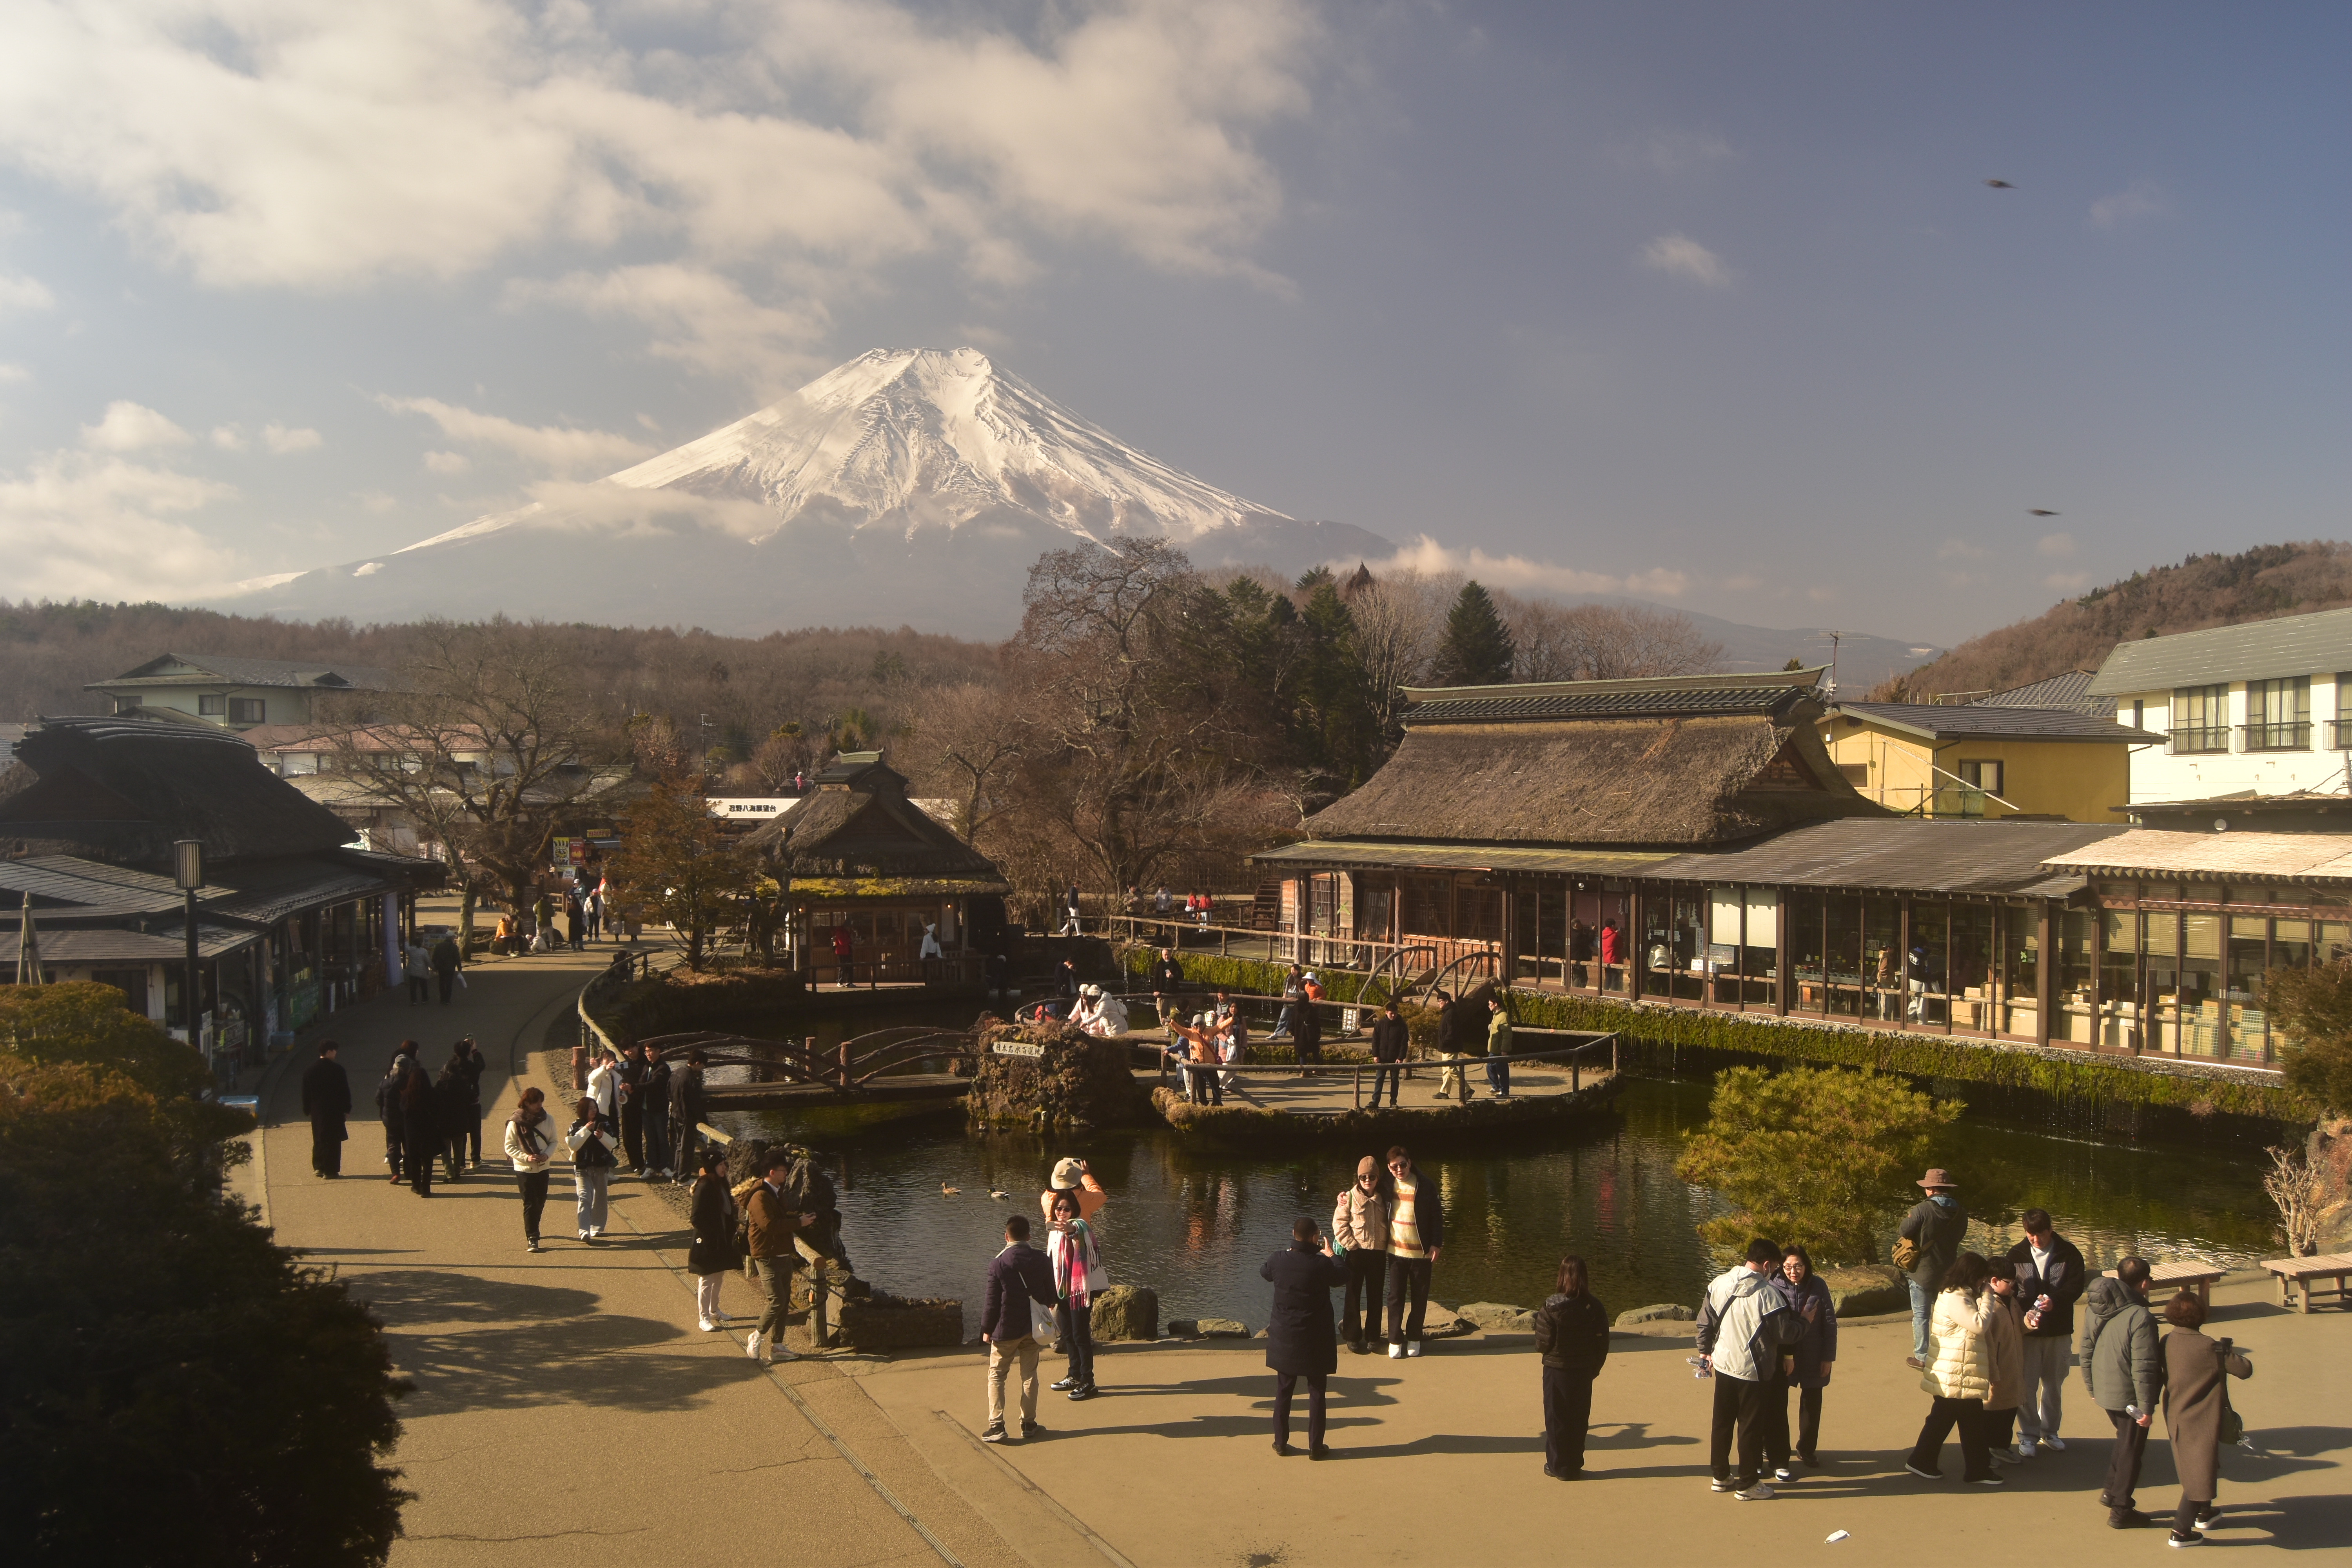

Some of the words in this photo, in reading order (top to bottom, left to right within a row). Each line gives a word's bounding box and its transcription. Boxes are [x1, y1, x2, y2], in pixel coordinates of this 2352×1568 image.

[996, 1044, 1041, 1055] 日本名水百選地
